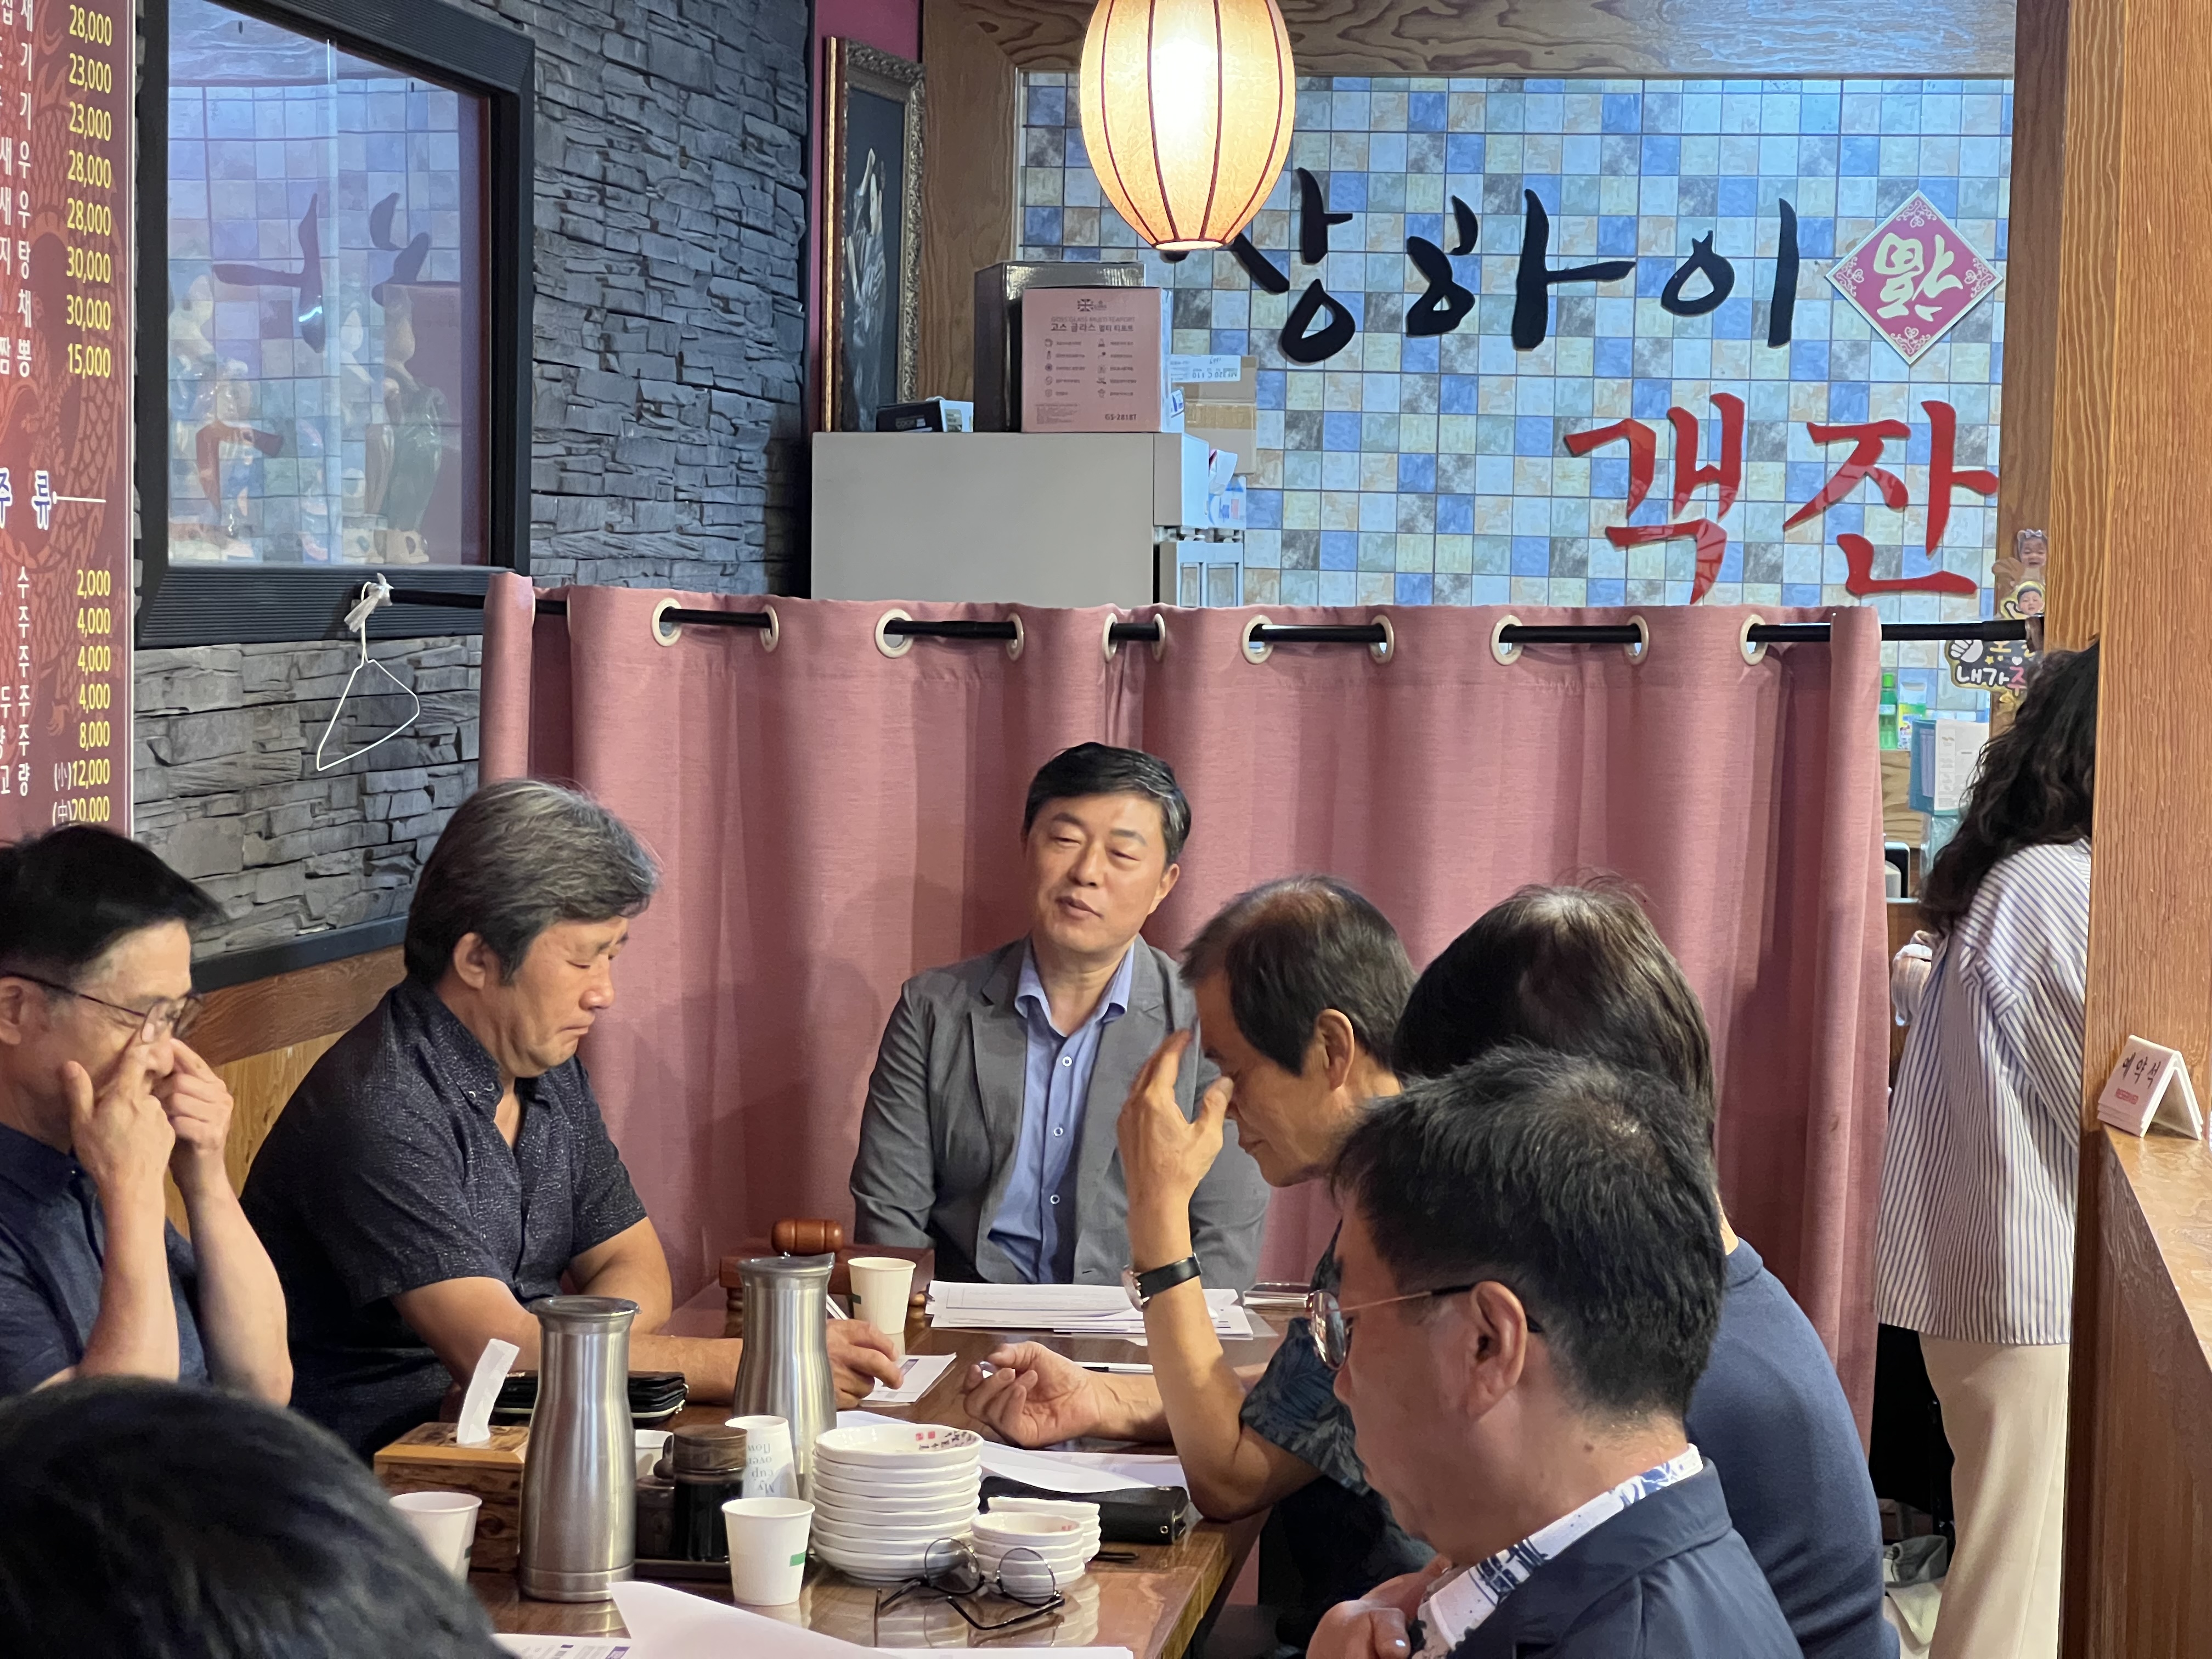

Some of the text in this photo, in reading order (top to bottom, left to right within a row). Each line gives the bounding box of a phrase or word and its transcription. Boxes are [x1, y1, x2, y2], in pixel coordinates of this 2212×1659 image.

[69, 4, 112, 46] 28,000
[69, 53, 112, 94] 23,000
[69, 101, 111, 142] 23,000
[67, 149, 111, 189] 28,000
[67, 198, 111, 236] 28,000
[66, 246, 111, 284] 30,000
[1160, 167, 1799, 363] 상하이
[66, 294, 111, 331] 30,000
[67, 343, 111, 380] 15,000
[1564, 393, 1999, 605] 객잔
[77, 569, 110, 599] 2,000
[18, 606, 110, 638] 주 4,000
[19, 646, 110, 677] 주 4,000
[79, 684, 110, 714] 4,000
[80, 720, 110, 752] 8,000
[2122, 1052, 2161, 1089] 예약석
